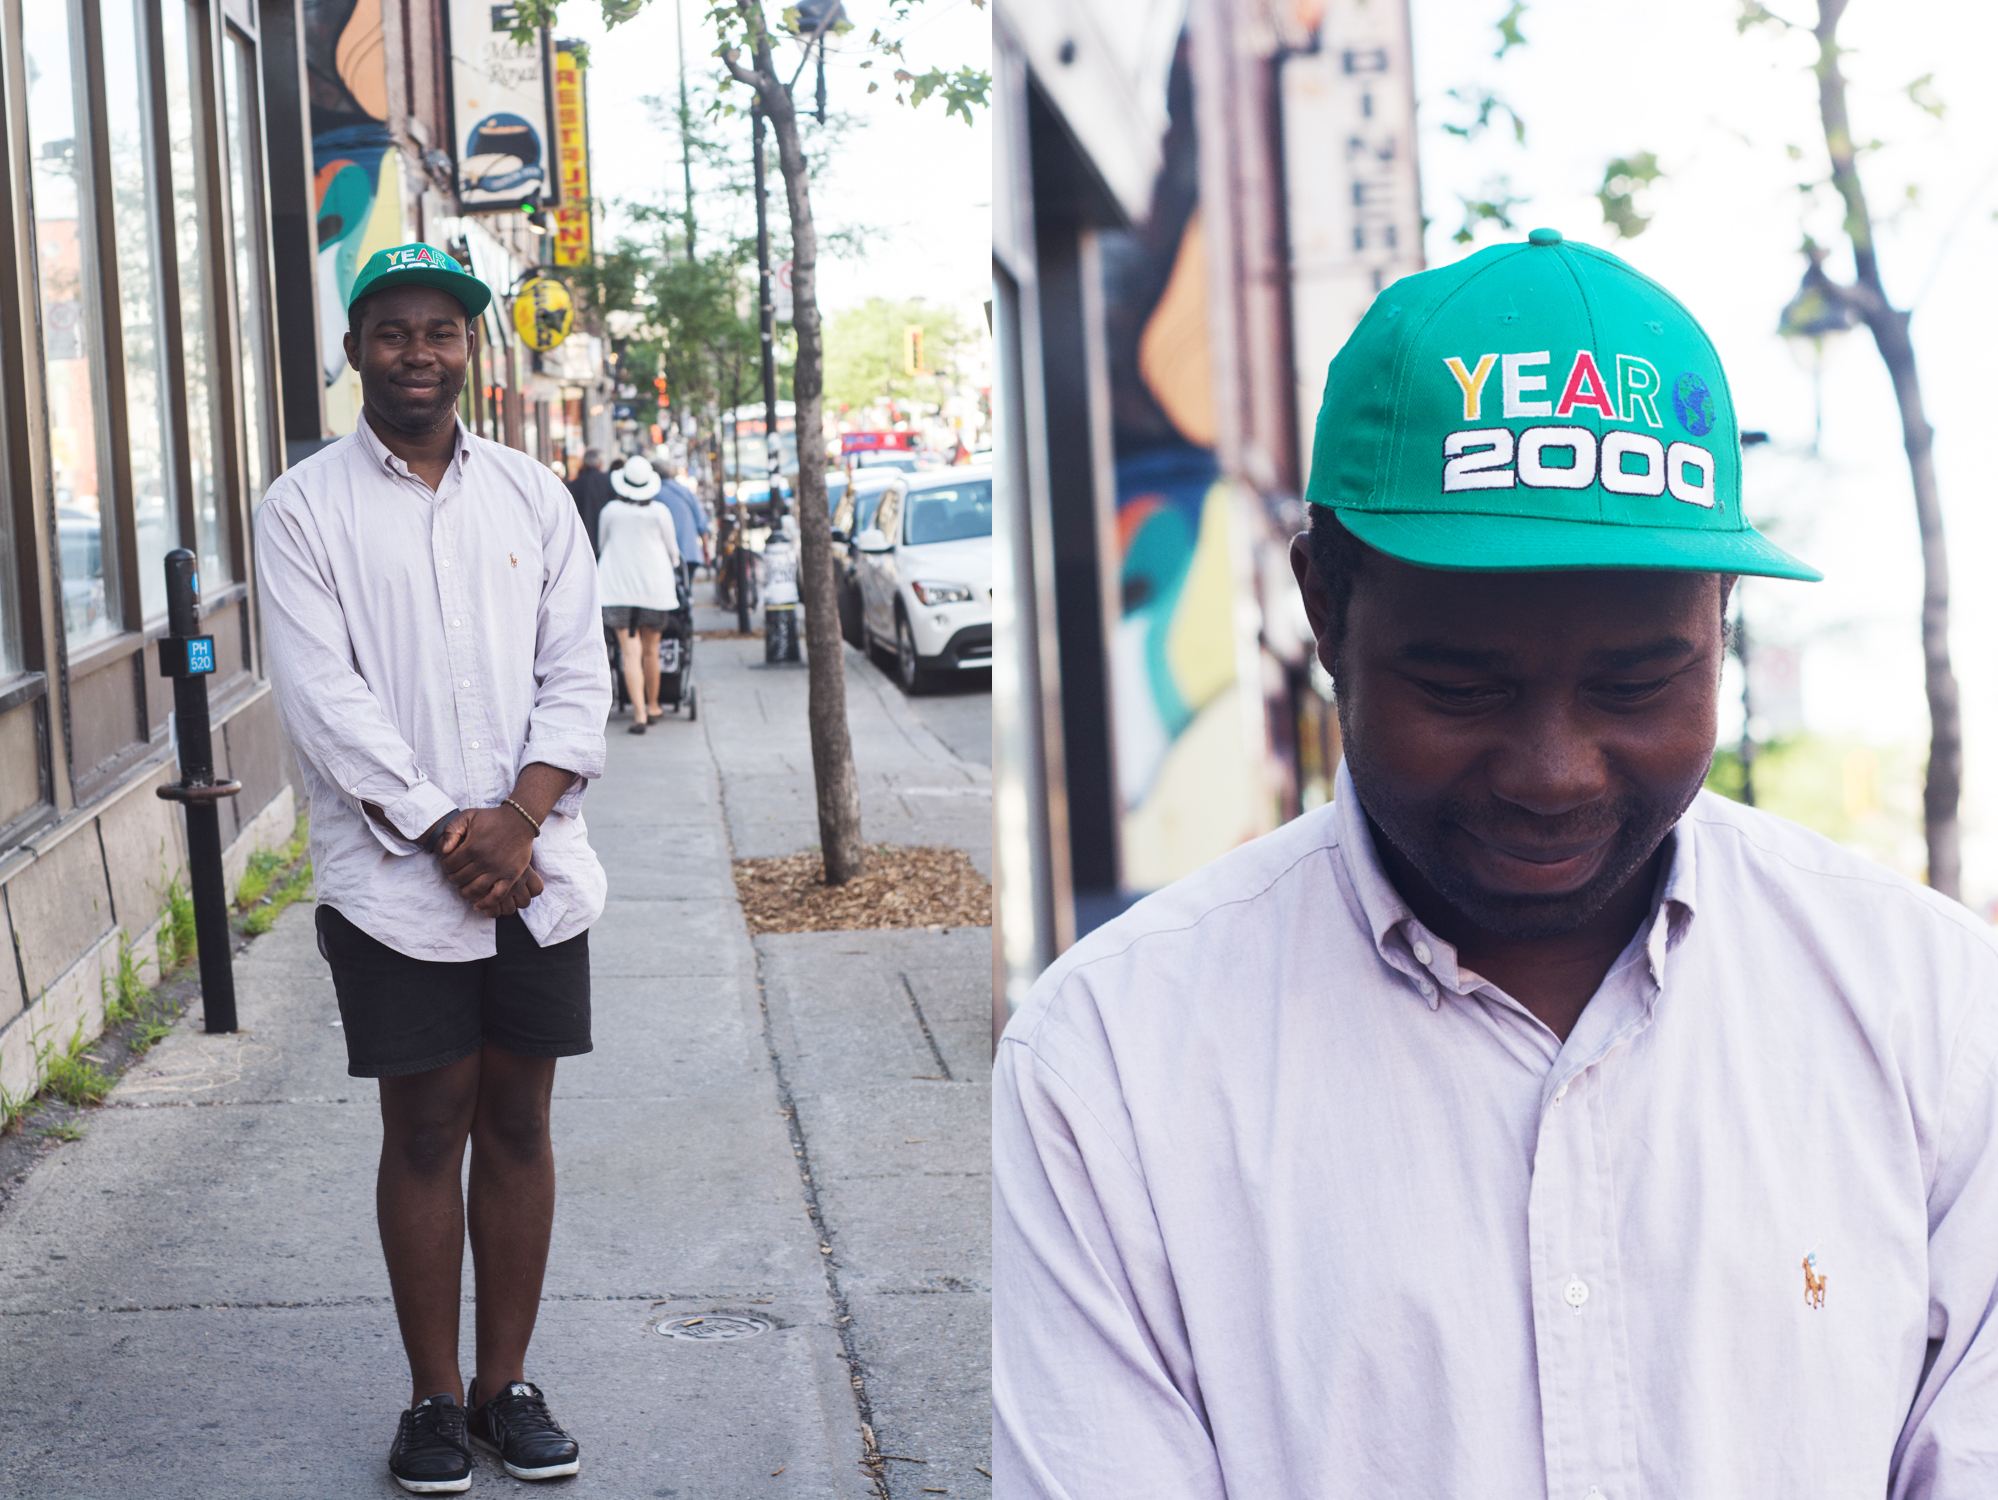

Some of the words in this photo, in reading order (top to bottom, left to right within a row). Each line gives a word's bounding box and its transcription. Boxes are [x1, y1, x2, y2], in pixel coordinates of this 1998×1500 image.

[386, 248, 446, 270] YEAR
[1443, 349, 1663, 428] YEAR
[1441, 425, 1715, 509] 2000
[192, 642, 208, 656] PH
[190, 655, 211, 670] 520
